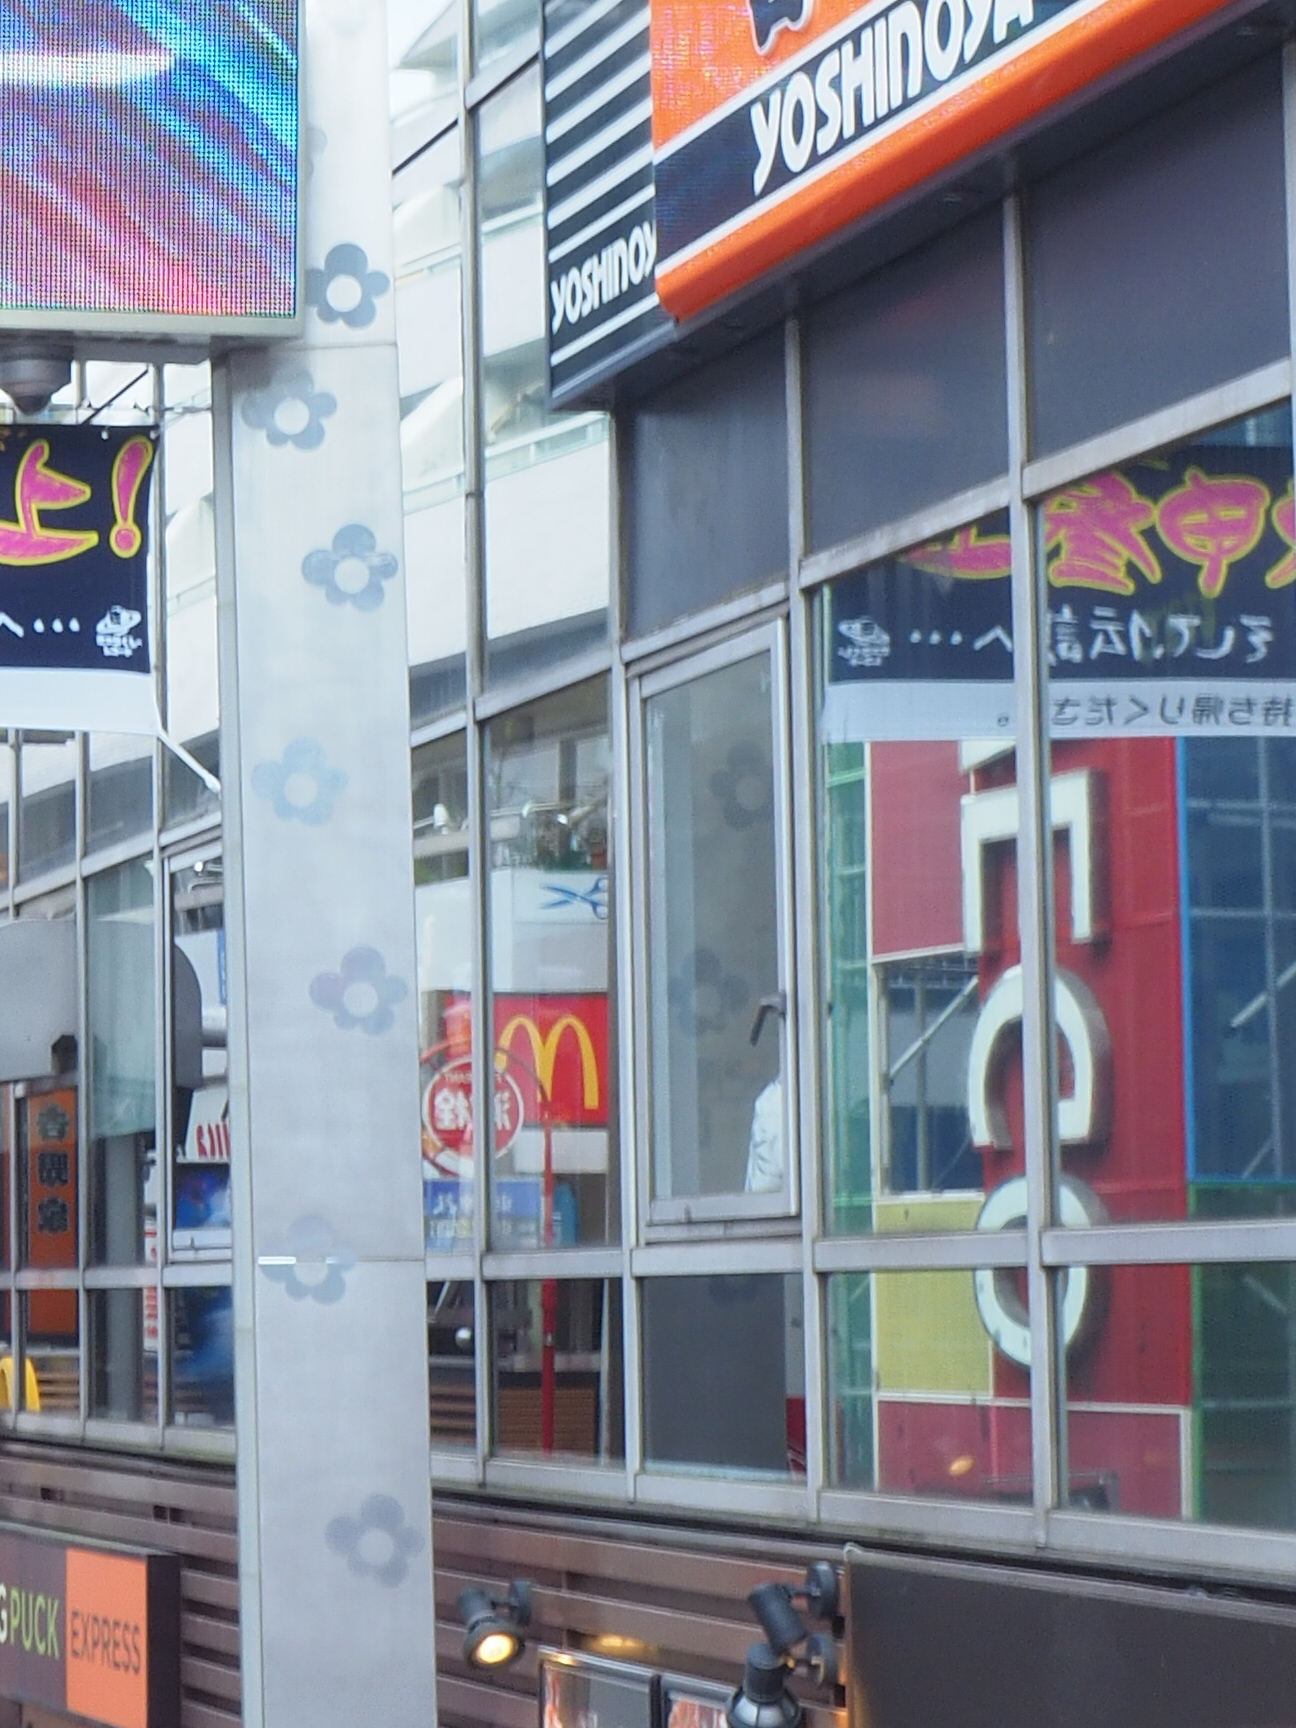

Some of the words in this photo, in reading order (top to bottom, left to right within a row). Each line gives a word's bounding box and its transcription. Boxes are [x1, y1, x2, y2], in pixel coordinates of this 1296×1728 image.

[550, 220, 657, 335] YOSHINOY
[9, 1586, 60, 1661] PUCK
[70, 1609, 143, 1676] EXPRESS
